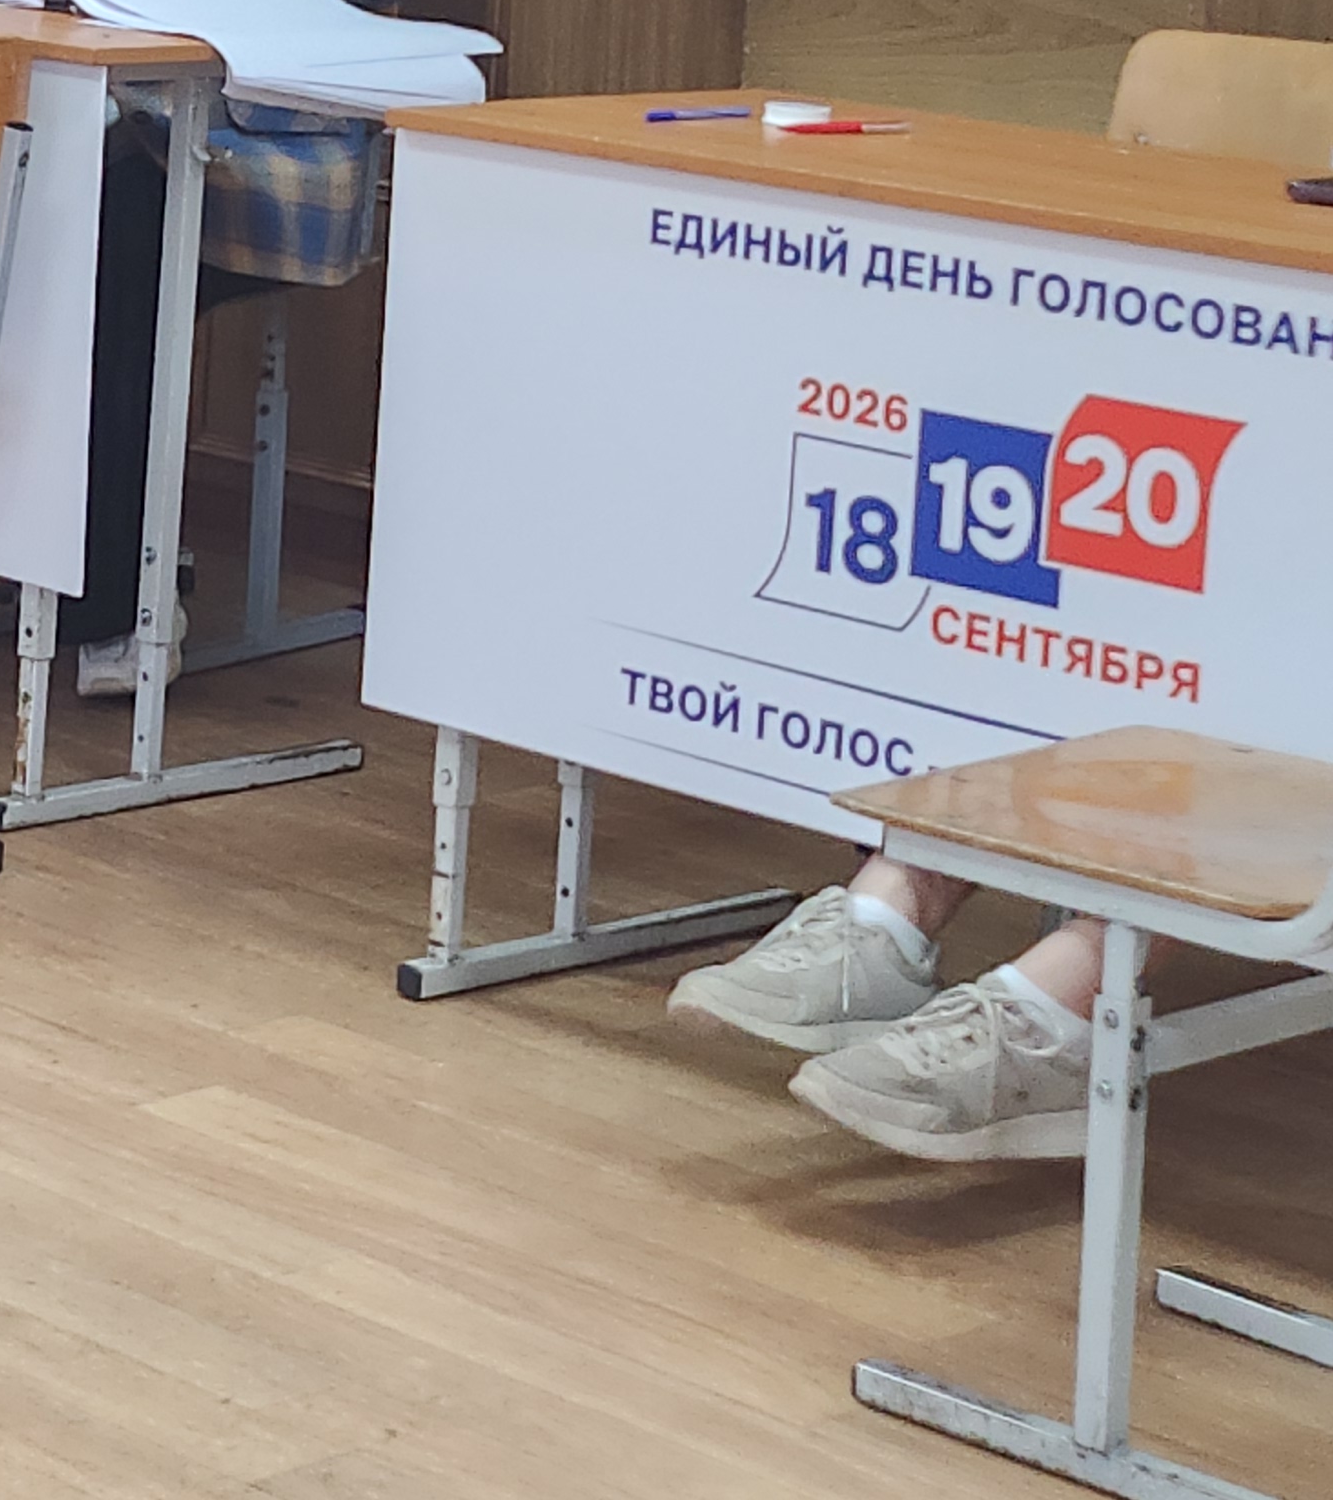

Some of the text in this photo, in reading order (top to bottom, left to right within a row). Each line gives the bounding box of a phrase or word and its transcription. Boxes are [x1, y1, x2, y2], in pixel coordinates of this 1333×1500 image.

[650, 207, 1333, 360] ЕДИНЫЙ ДЕНЬ ГОЛОСОВАН
[796, 376, 910, 434] 2026
[804, 431, 1202, 586] 18 19 20
[929, 603, 1202, 705] СЕНТЯБРЯ
[619, 666, 915, 778] ТВОЙ ГОЛОС
